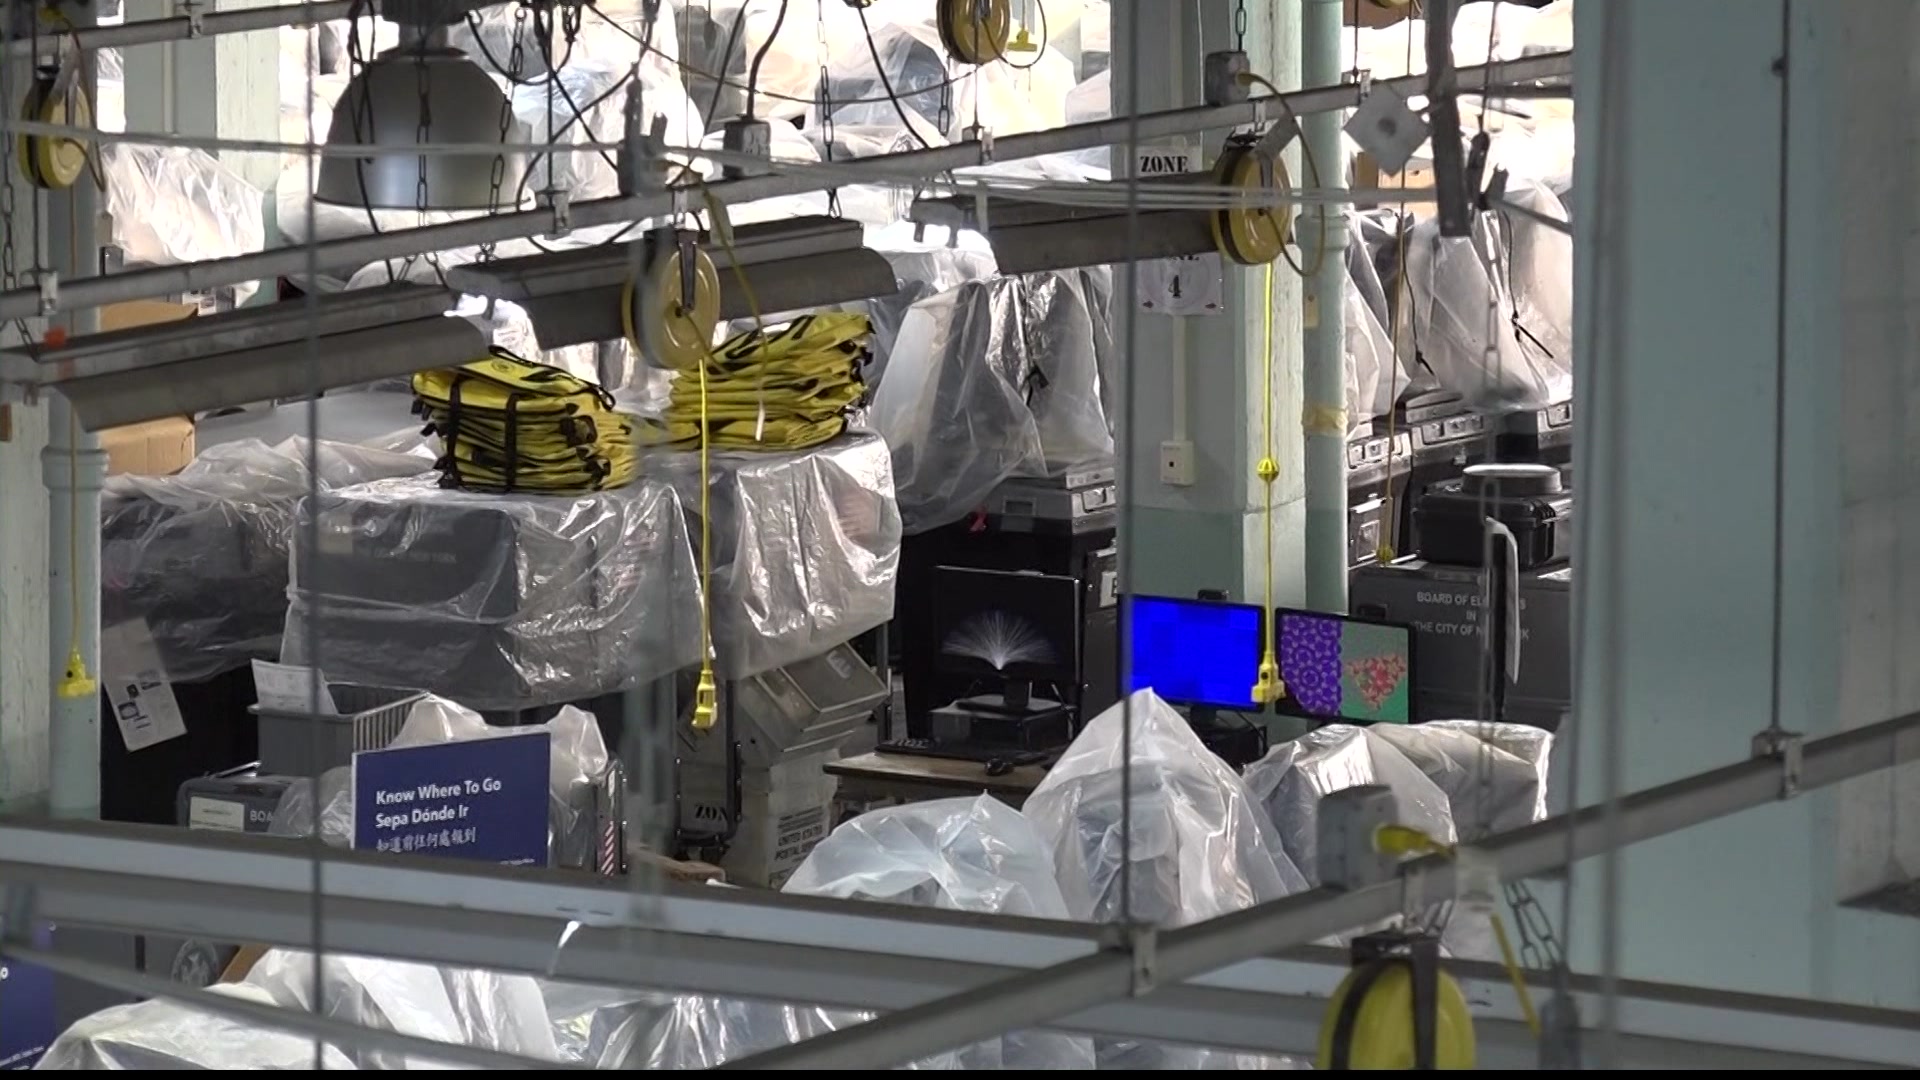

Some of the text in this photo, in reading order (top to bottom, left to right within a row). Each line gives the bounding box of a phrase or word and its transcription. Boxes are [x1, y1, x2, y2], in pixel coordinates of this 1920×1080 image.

[1140, 156, 1188, 172] ZONE
[1168, 275, 1182, 298] 4
[1417, 591, 1452, 604] BOARD
[1454, 595, 1468, 605] OF
[1466, 609, 1476, 621] IN
[1414, 621, 1433, 632] THE
[1435, 623, 1458, 634] CITY
[1460, 626, 1474, 636] OF
[376, 777, 502, 804] Know Where To Go
[250, 810, 273, 822] BOA
[375, 804, 470, 830] Sepa Dónde Ir
[694, 804, 728, 821] ZON
[0, 966, 9, 980] o
